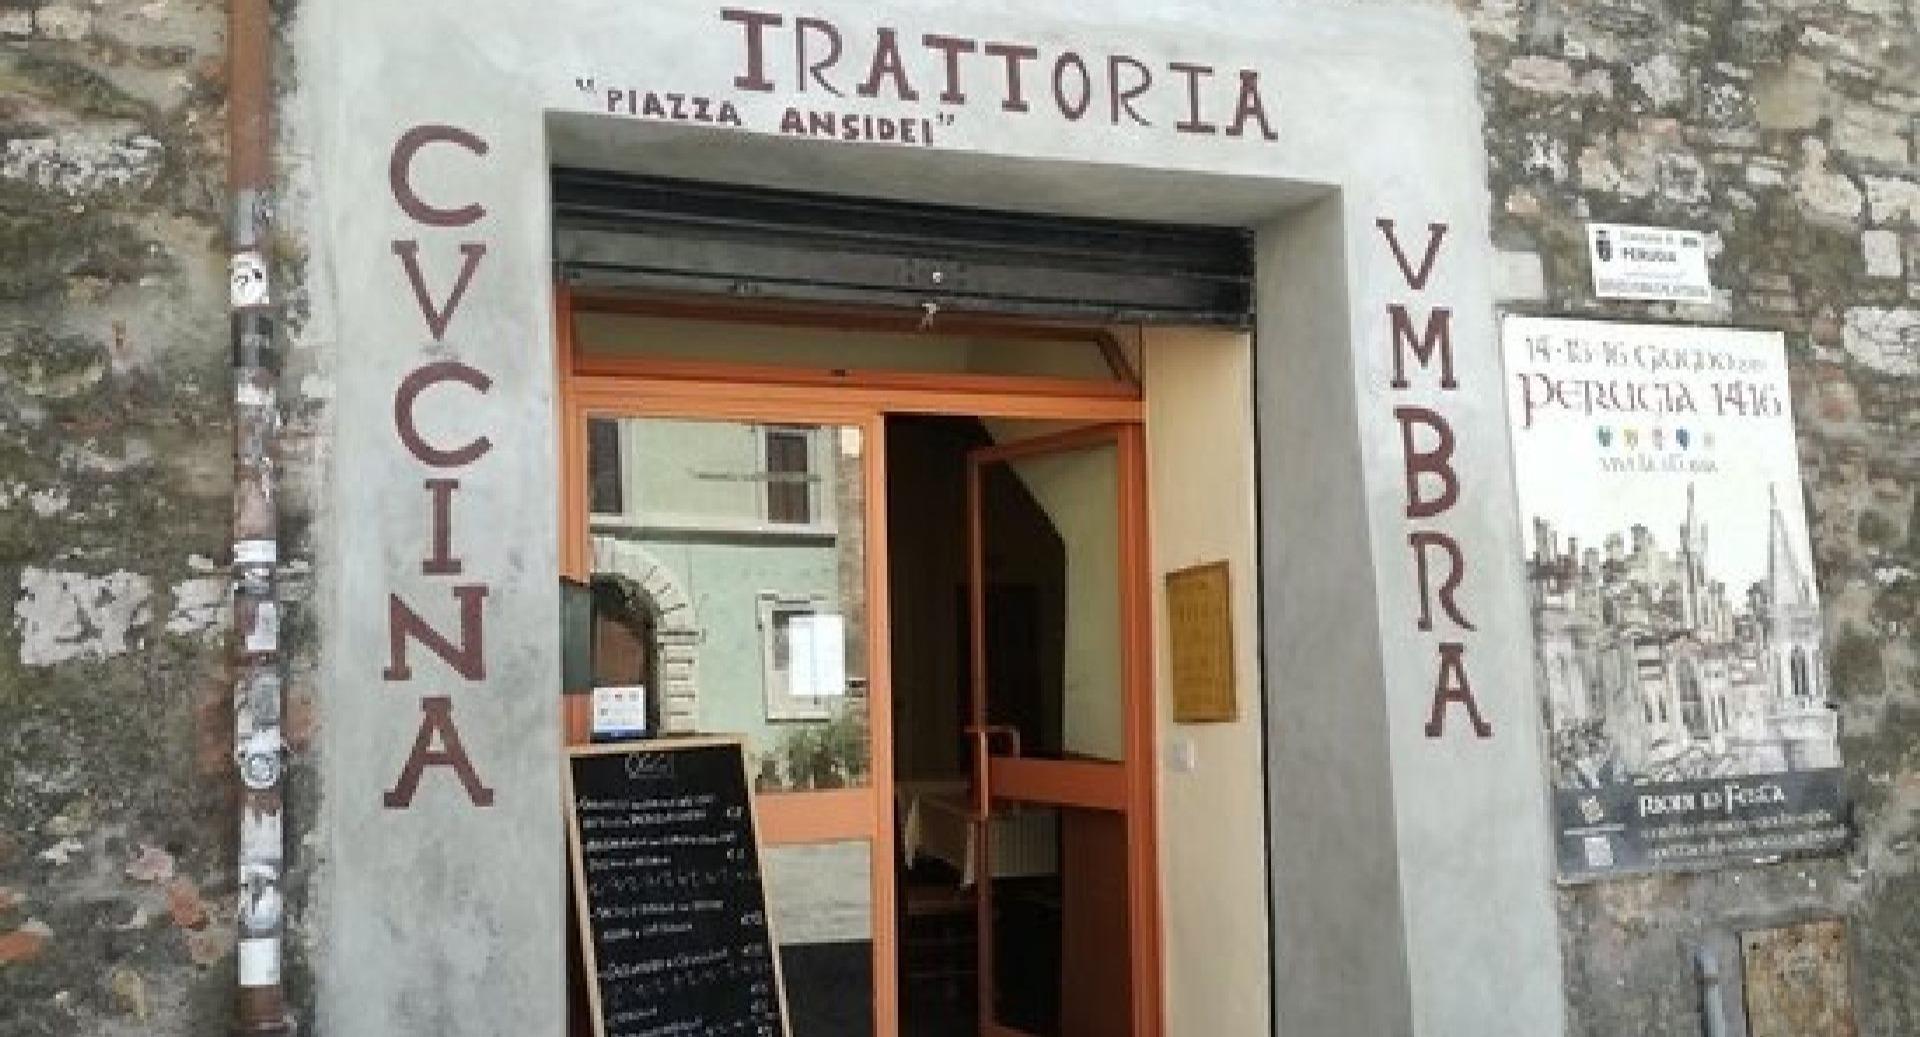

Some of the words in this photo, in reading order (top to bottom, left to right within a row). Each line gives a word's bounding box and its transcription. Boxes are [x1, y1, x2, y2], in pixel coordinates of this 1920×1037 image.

[720, 6, 1278, 141] TRATTORIA
[383, 124, 494, 807] CVCINA
[1376, 219, 1492, 738] VMBRA
[1709, 379, 1782, 416] 1416
